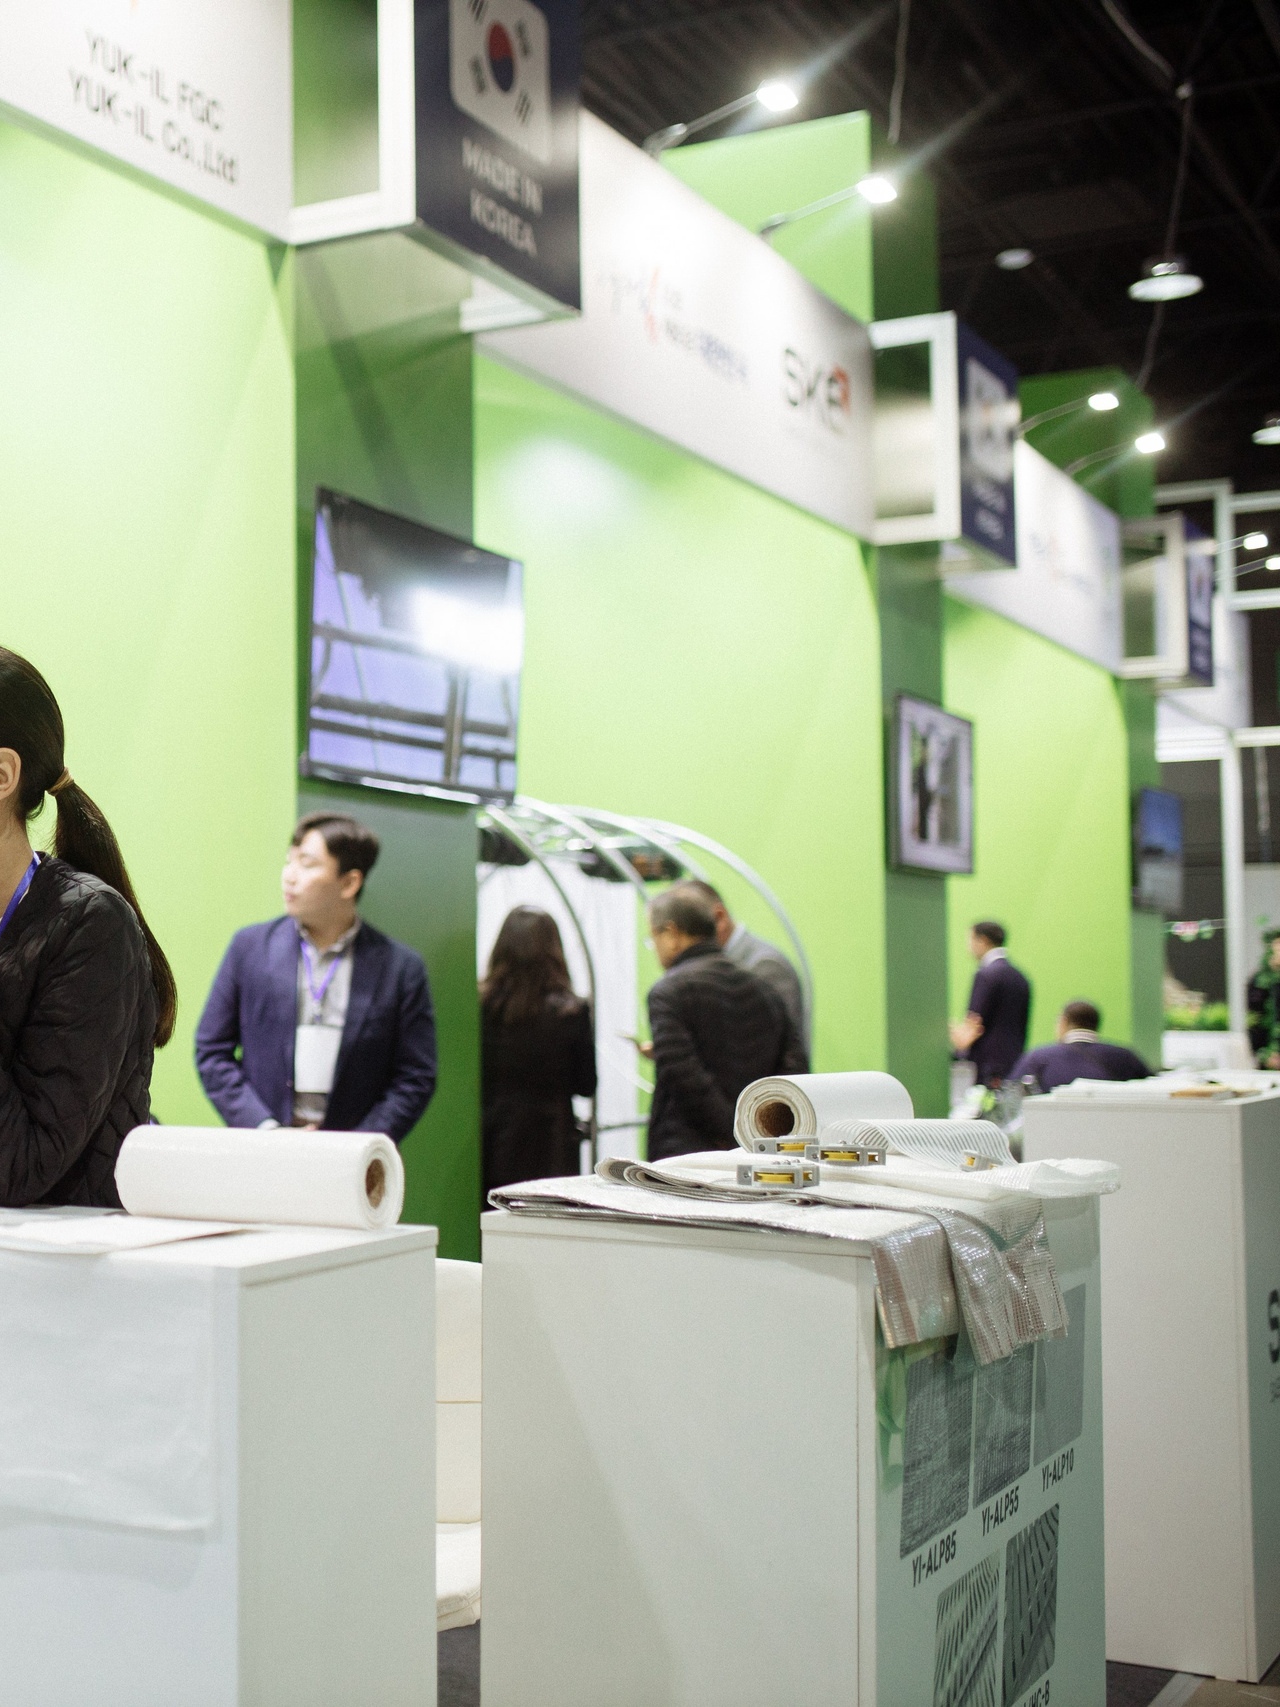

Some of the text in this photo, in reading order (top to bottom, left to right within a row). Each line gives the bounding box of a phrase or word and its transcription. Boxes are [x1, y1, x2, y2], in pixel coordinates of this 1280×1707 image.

[462, 137, 543, 216] MADE IN
[470, 188, 537, 258] KOREA
[1042, 1447, 1075, 1492] YI-ALP10
[981, 1485, 1020, 1537] YI-ALP55
[912, 1529, 957, 1588] YI-ALP85
